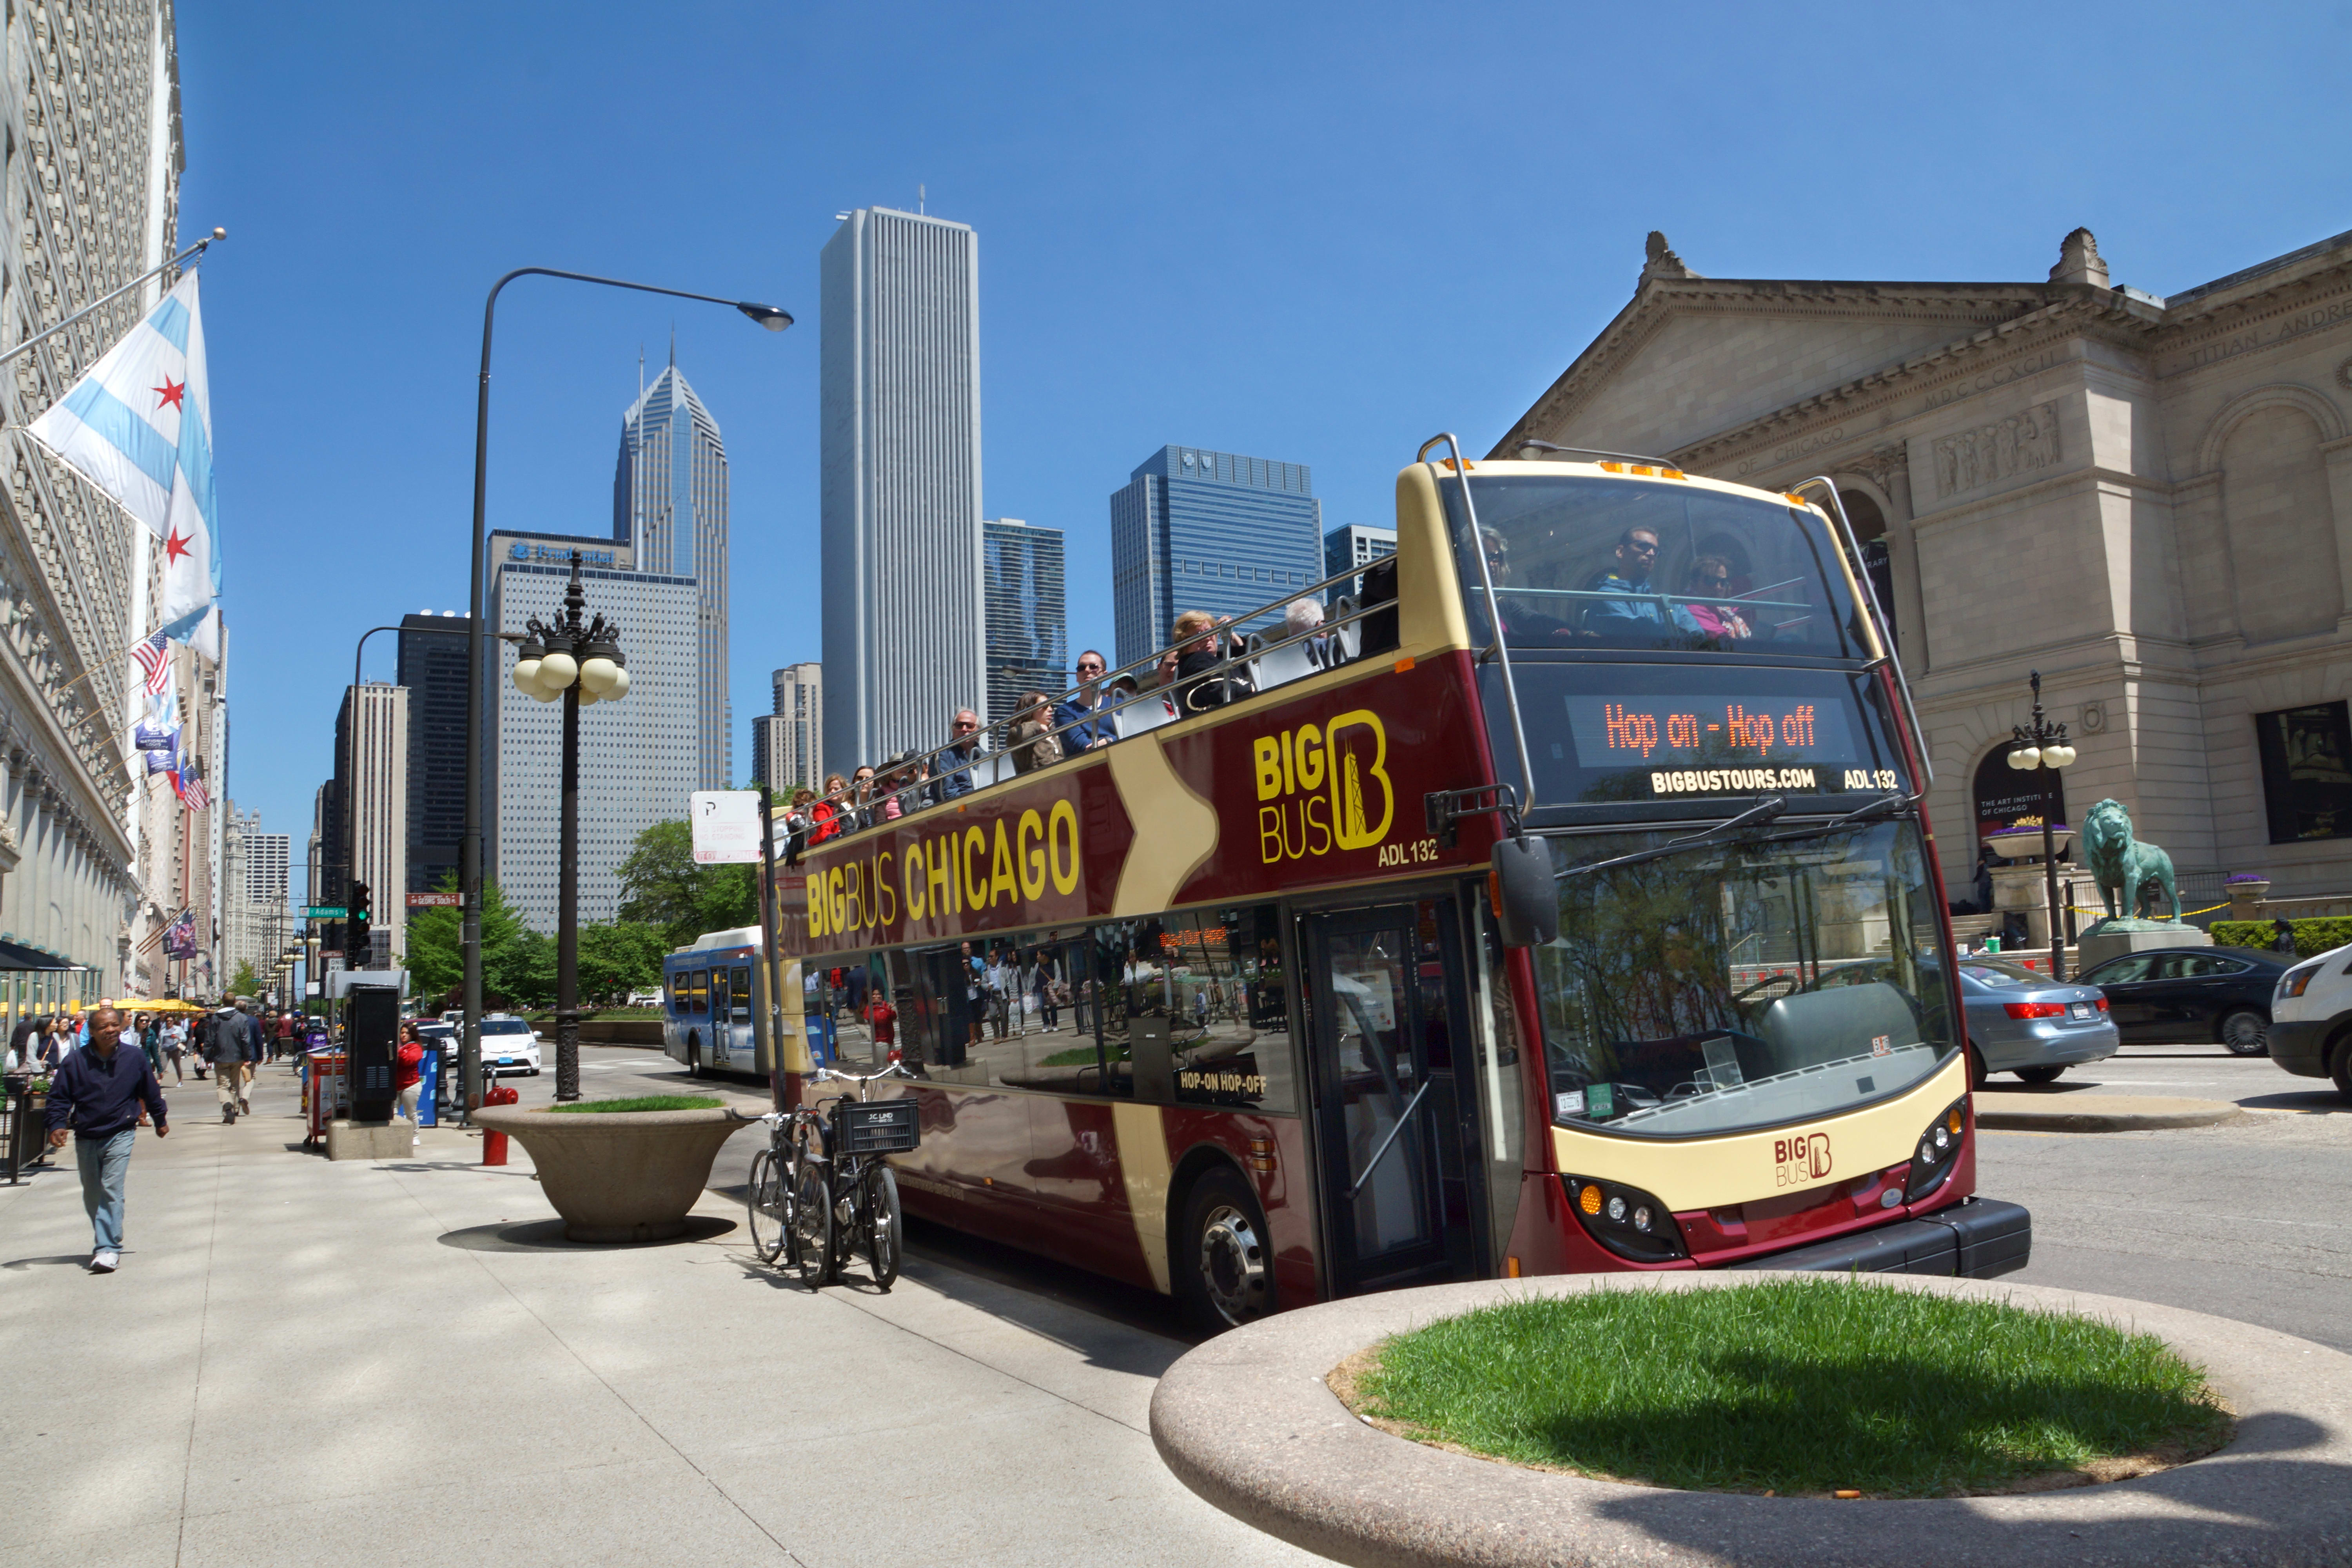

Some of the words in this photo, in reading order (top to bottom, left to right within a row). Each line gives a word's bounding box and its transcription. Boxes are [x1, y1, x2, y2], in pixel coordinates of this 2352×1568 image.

[2188, 331, 2258, 363] TITIAN
[1738, 457, 1757, 474] OF
[1775, 428, 1843, 461] CHICAGO
[537, 544, 615, 563] Prudntial
[1605, 704, 1658, 757] Hop
[1667, 714, 1699, 748] on
[1727, 705, 1774, 756] Hop
[1782, 705, 1814, 746] off
[1254, 723, 1325, 801] BIG
[1651, 768, 1815, 793] BIGBUSTOURS.COM
[1844, 770, 1874, 789] ADL
[1873, 770, 1898, 789] 132
[1993, 804, 2027, 814] CHICAGO
[2013, 792, 2053, 802] INSTITE
[1259, 795, 1331, 864] BUS
[905, 799, 1080, 921] CHICAGO
[1378, 843, 1410, 867] ADL
[1410, 838, 1439, 862] 132
[1180, 1072, 1218, 1090] HOP-ON
[1220, 1073, 1267, 1093] HOP-OFF
[1775, 1136, 1806, 1164] BIG
[1776, 1161, 1808, 1187] BUS
